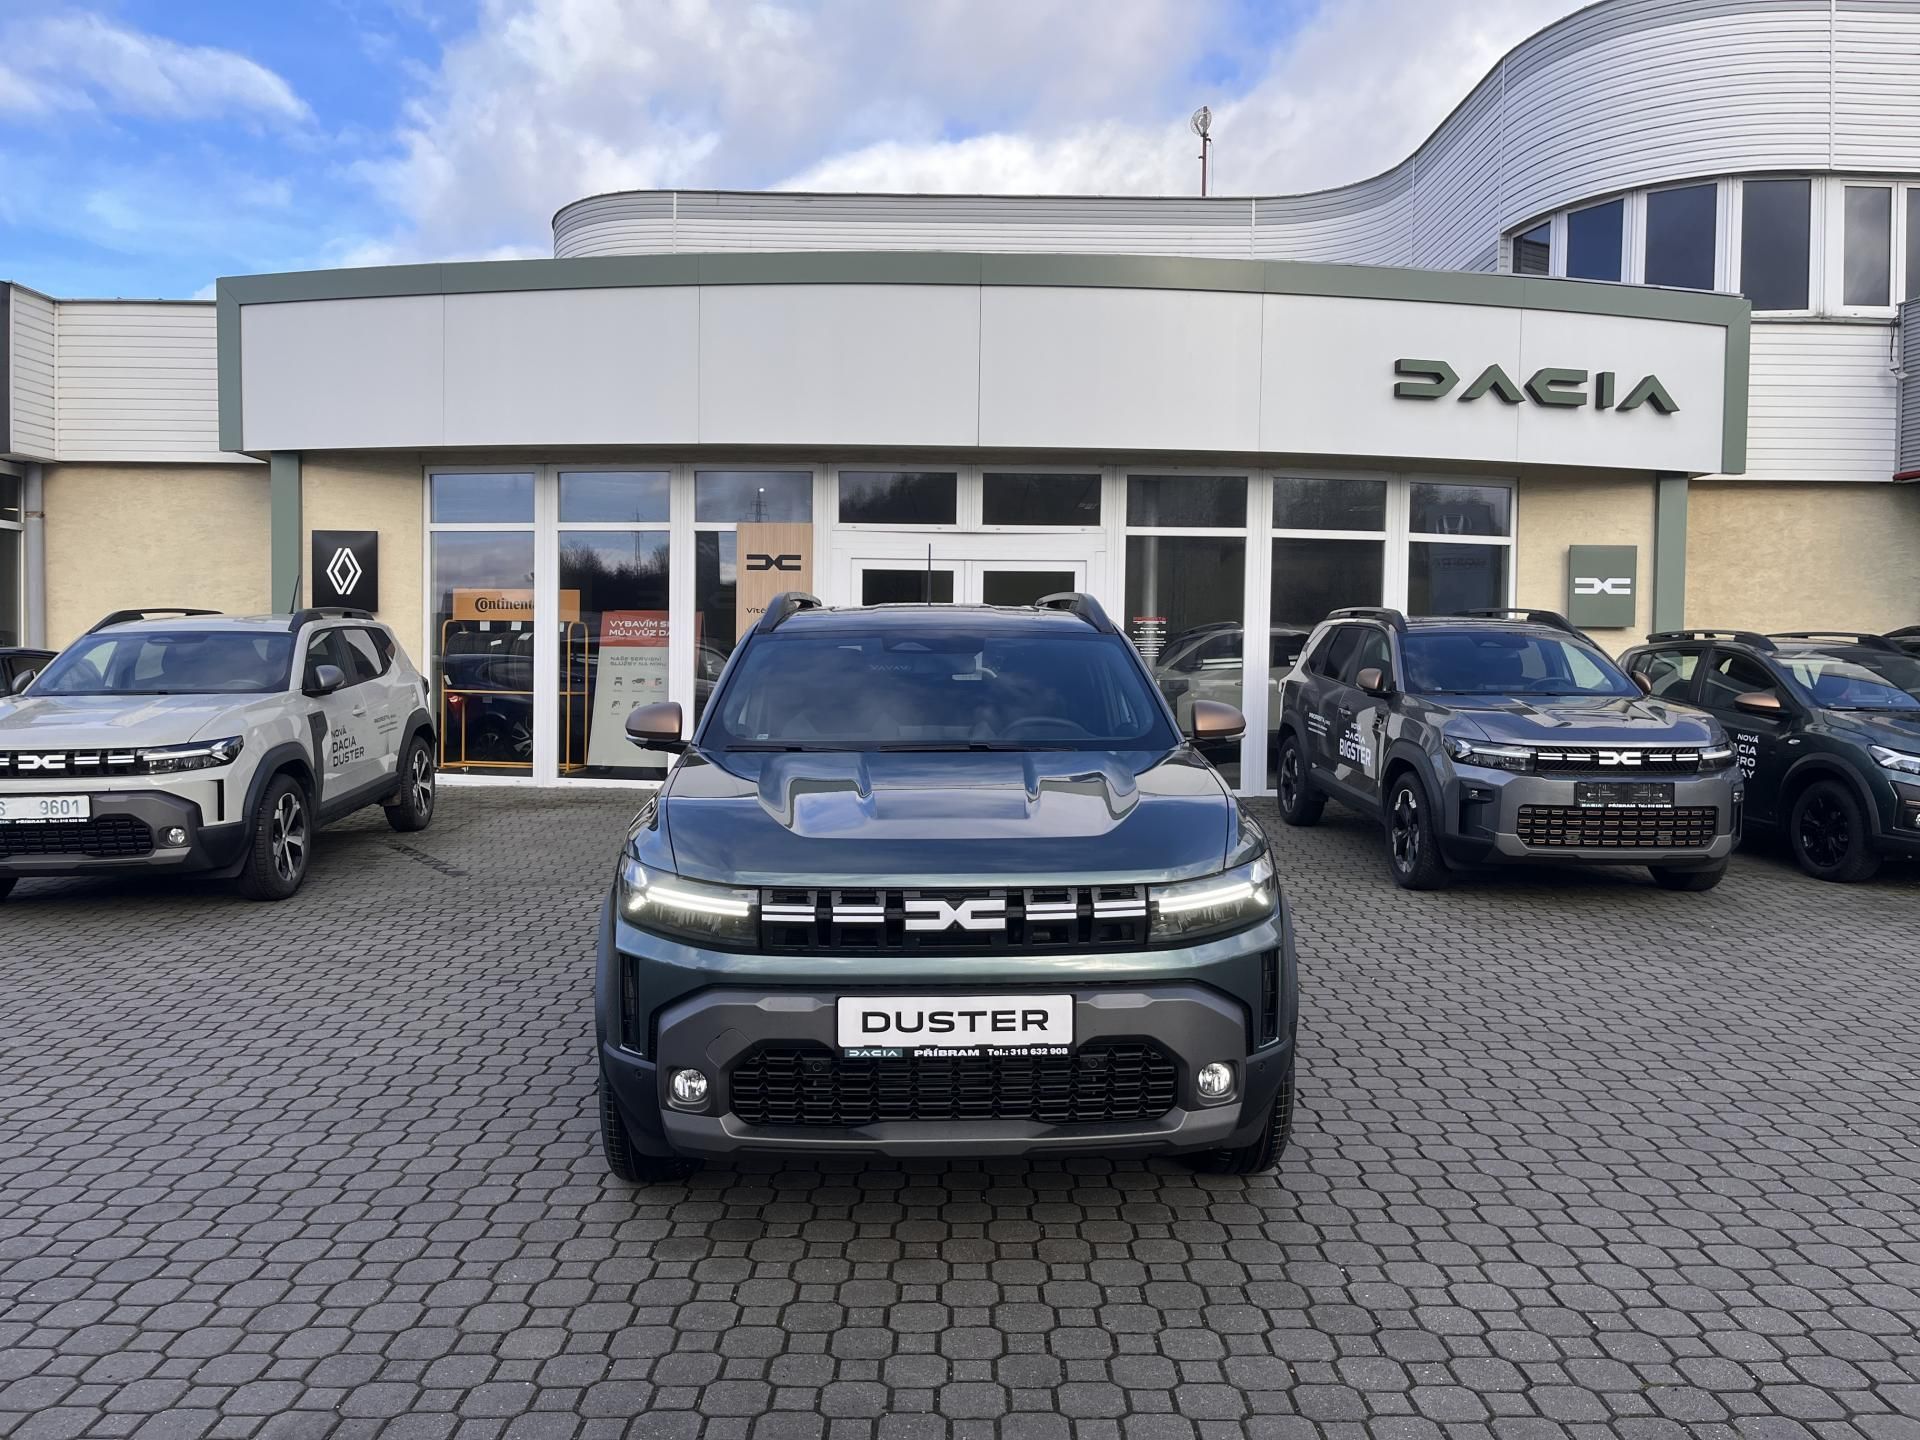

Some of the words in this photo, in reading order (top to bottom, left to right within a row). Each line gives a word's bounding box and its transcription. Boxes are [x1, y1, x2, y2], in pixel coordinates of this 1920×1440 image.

[1394, 358, 1680, 414] DACIA
[609, 619, 657, 627] VYBAVÍM
[609, 627, 631, 636] MŮJ
[635, 627, 656, 636] VŮZ
[332, 736, 356, 753] DACIA
[1345, 730, 1365, 744] DACIA
[1737, 733, 1759, 743] NOVÁ
[333, 746, 365, 767] DUSTER
[1339, 737, 1371, 767] BIGSTER
[40, 799, 79, 815] 9601
[862, 1009, 1048, 1033] DUSTER
[914, 1048, 980, 1057] PŘÍBRAM
[987, 1048, 1009, 1056] Tel.:
[1010, 1048, 1028, 1056] 318
[1030, 1047, 1048, 1055] 632
[1050, 1047, 1068, 1055] 908
